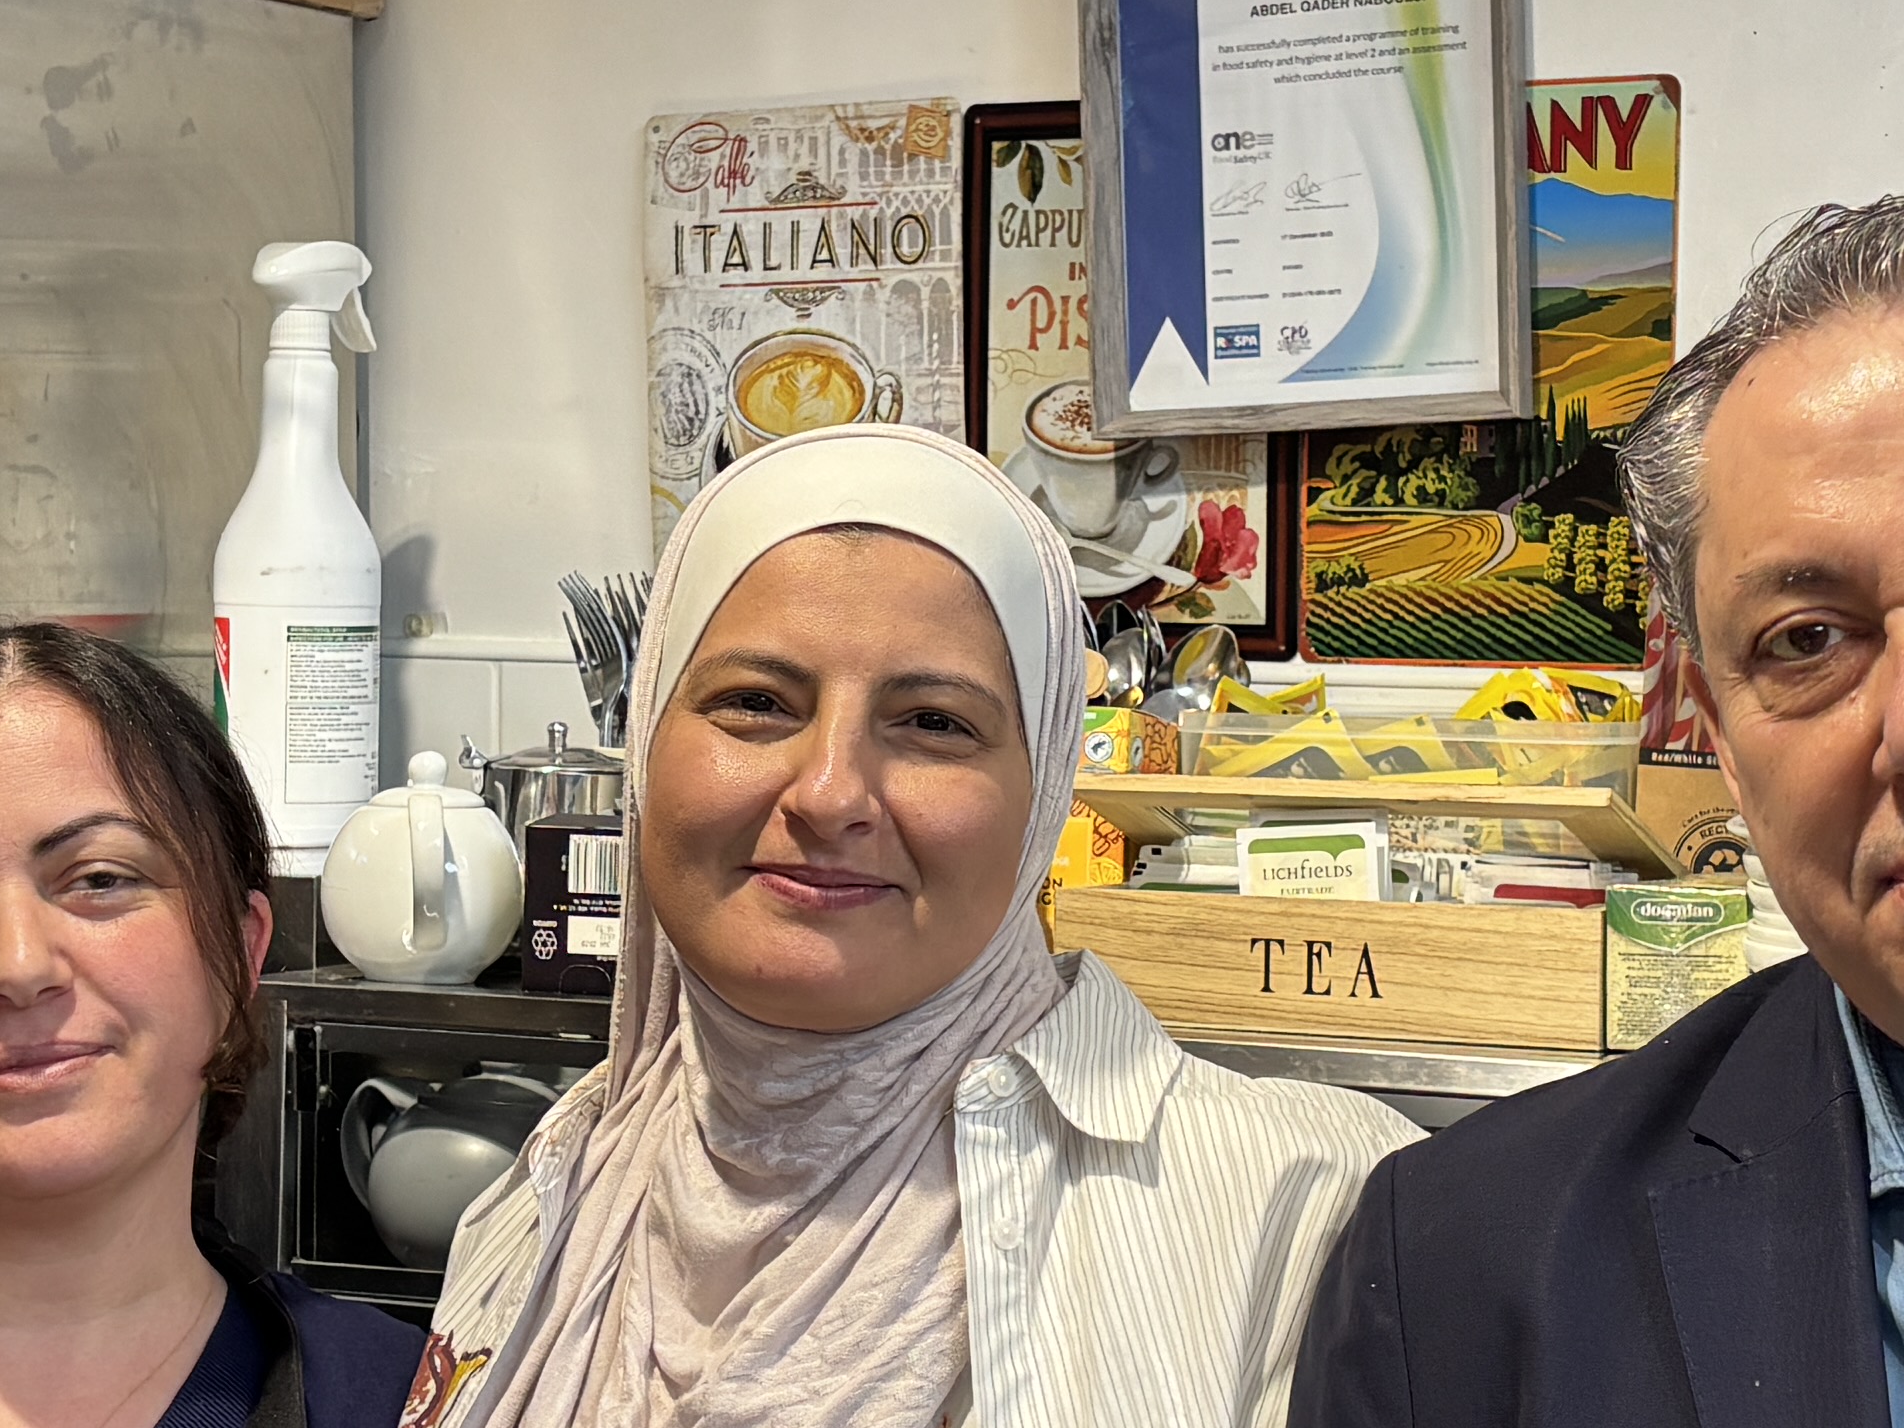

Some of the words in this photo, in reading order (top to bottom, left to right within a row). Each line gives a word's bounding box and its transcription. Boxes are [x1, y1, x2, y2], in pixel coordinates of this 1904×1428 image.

[1250, 2, 1297, 18] ABDEL
[674, 214, 932, 275] ITALIANO
[1250, 937, 1384, 999] TEA
